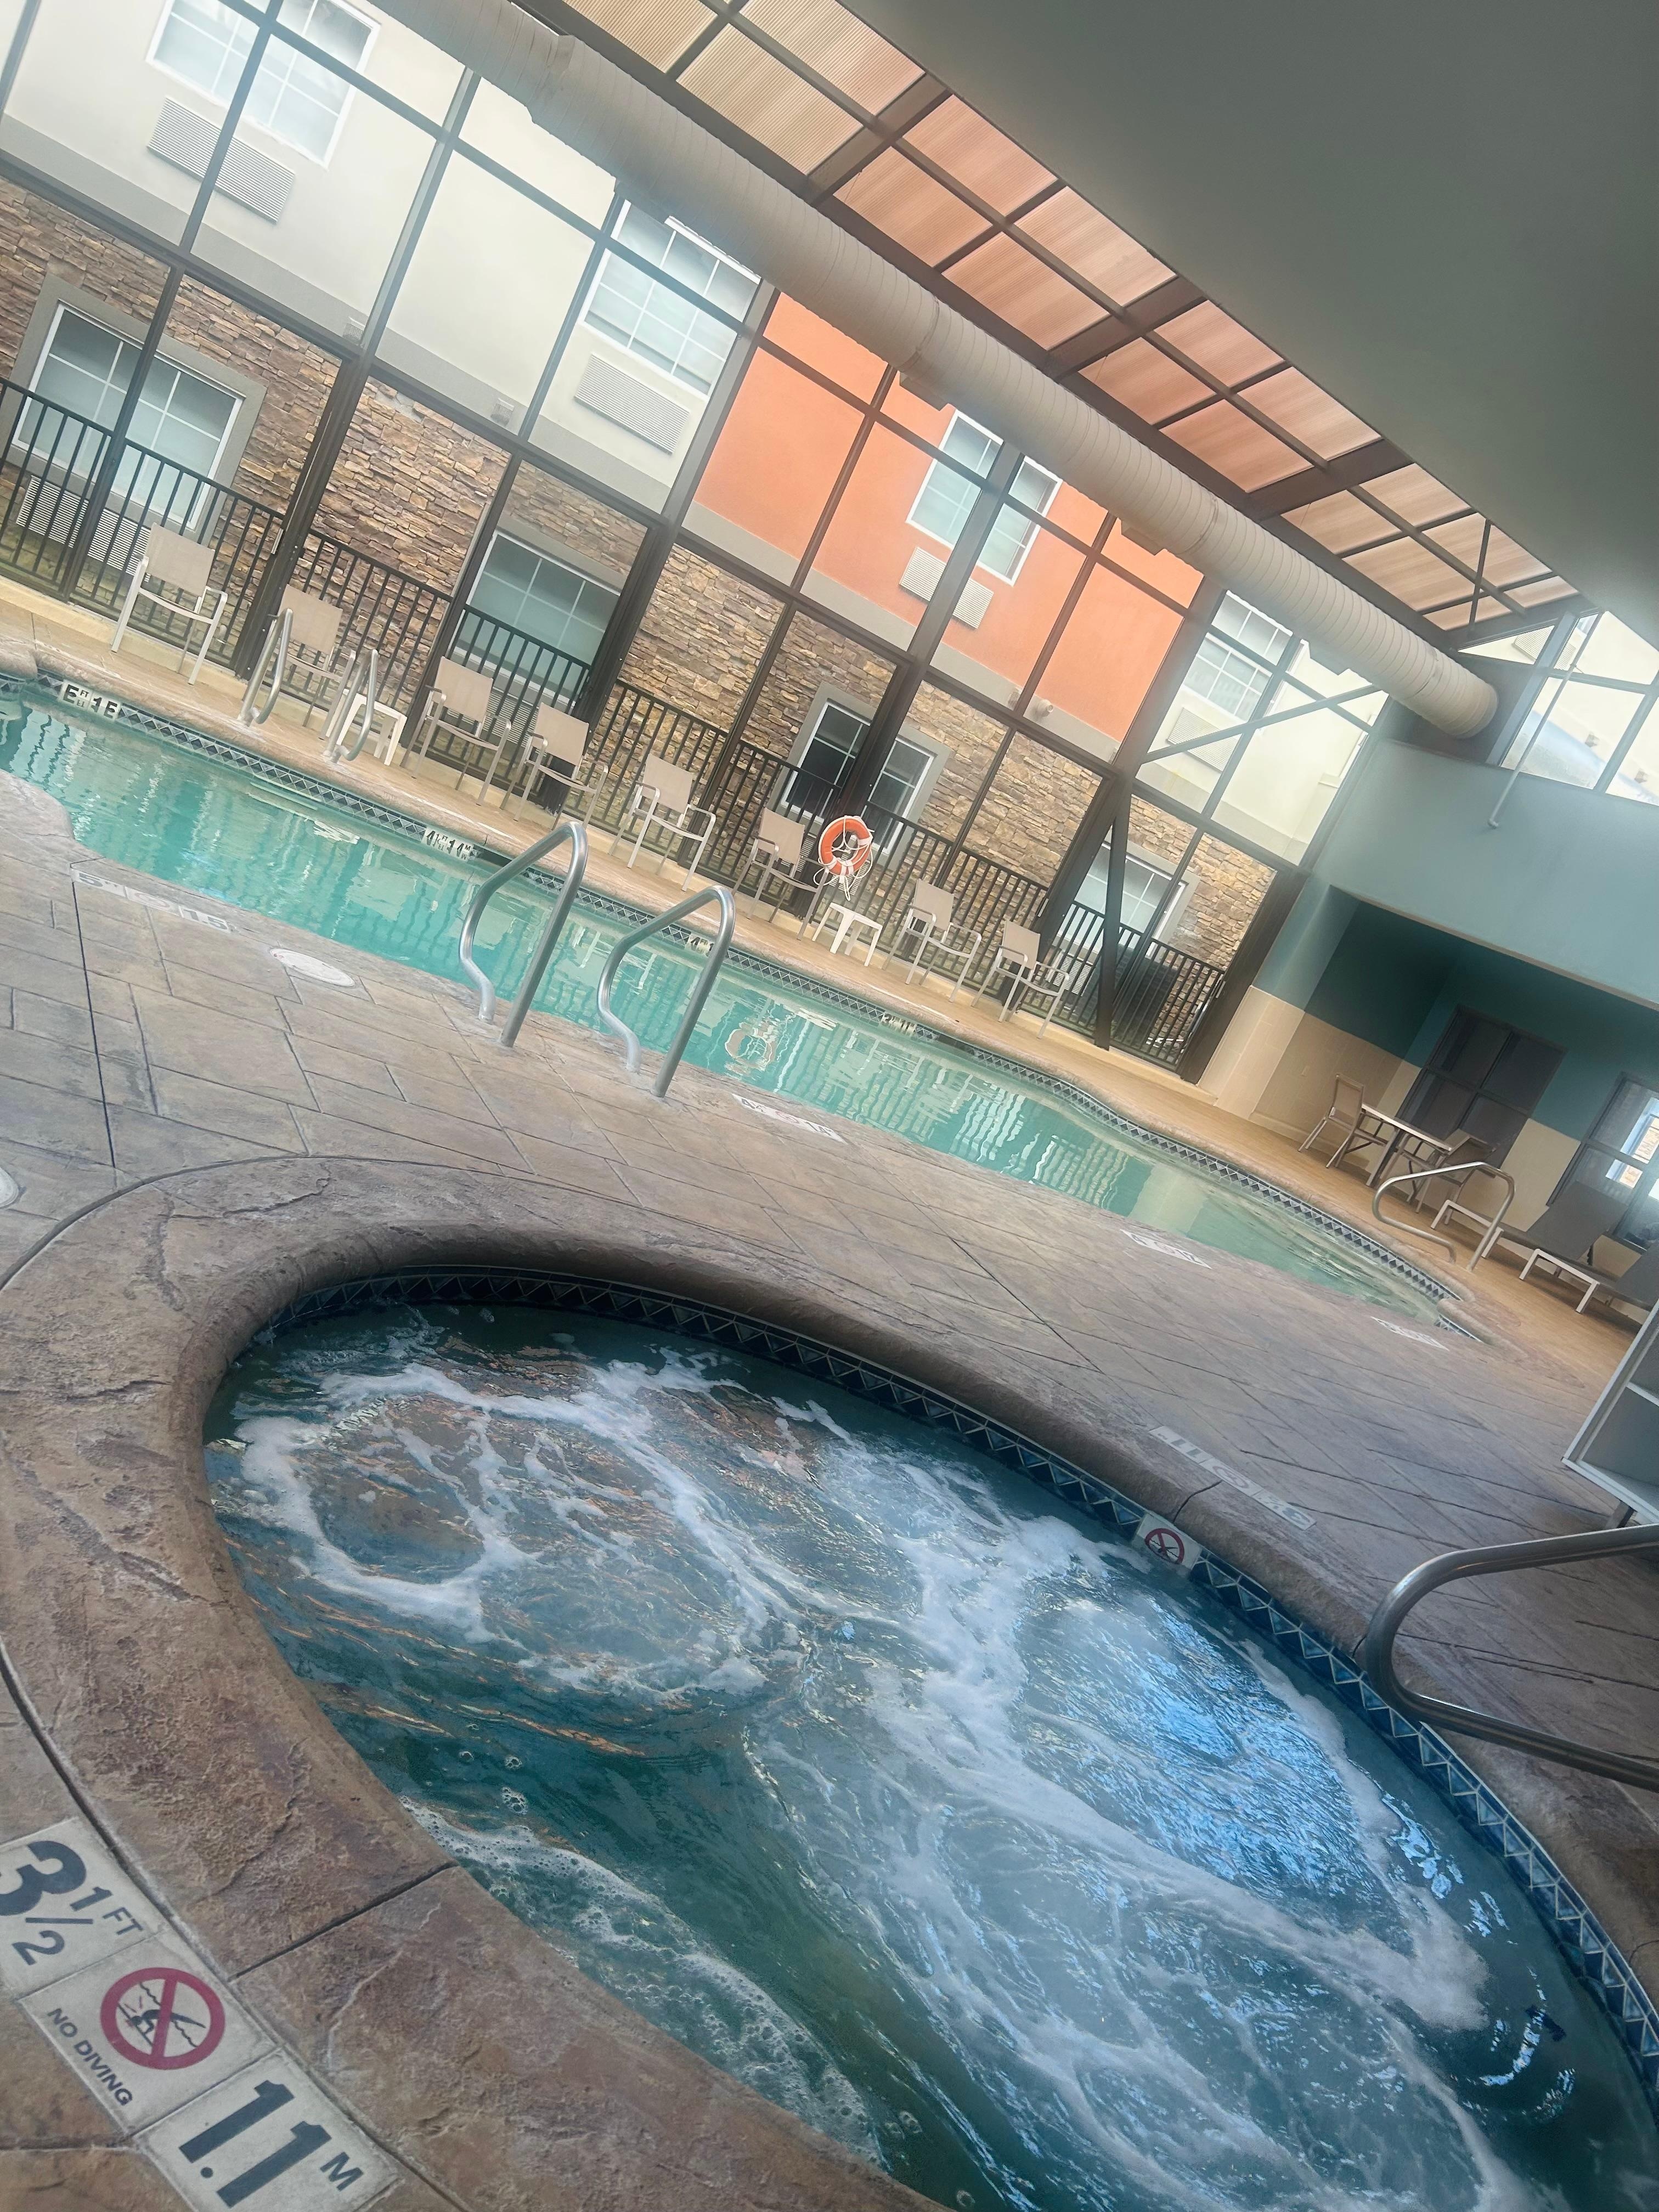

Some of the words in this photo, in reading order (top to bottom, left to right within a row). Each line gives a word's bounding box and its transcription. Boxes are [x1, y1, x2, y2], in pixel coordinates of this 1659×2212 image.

[78, 873, 103, 887] 5
[0, 1841, 87, 1916] 3
[102, 1907, 143, 1935] FT
[47, 2007, 77, 2038] NO
[74, 2039, 133, 2106] DIVING
[320, 2152, 363, 2192] M
